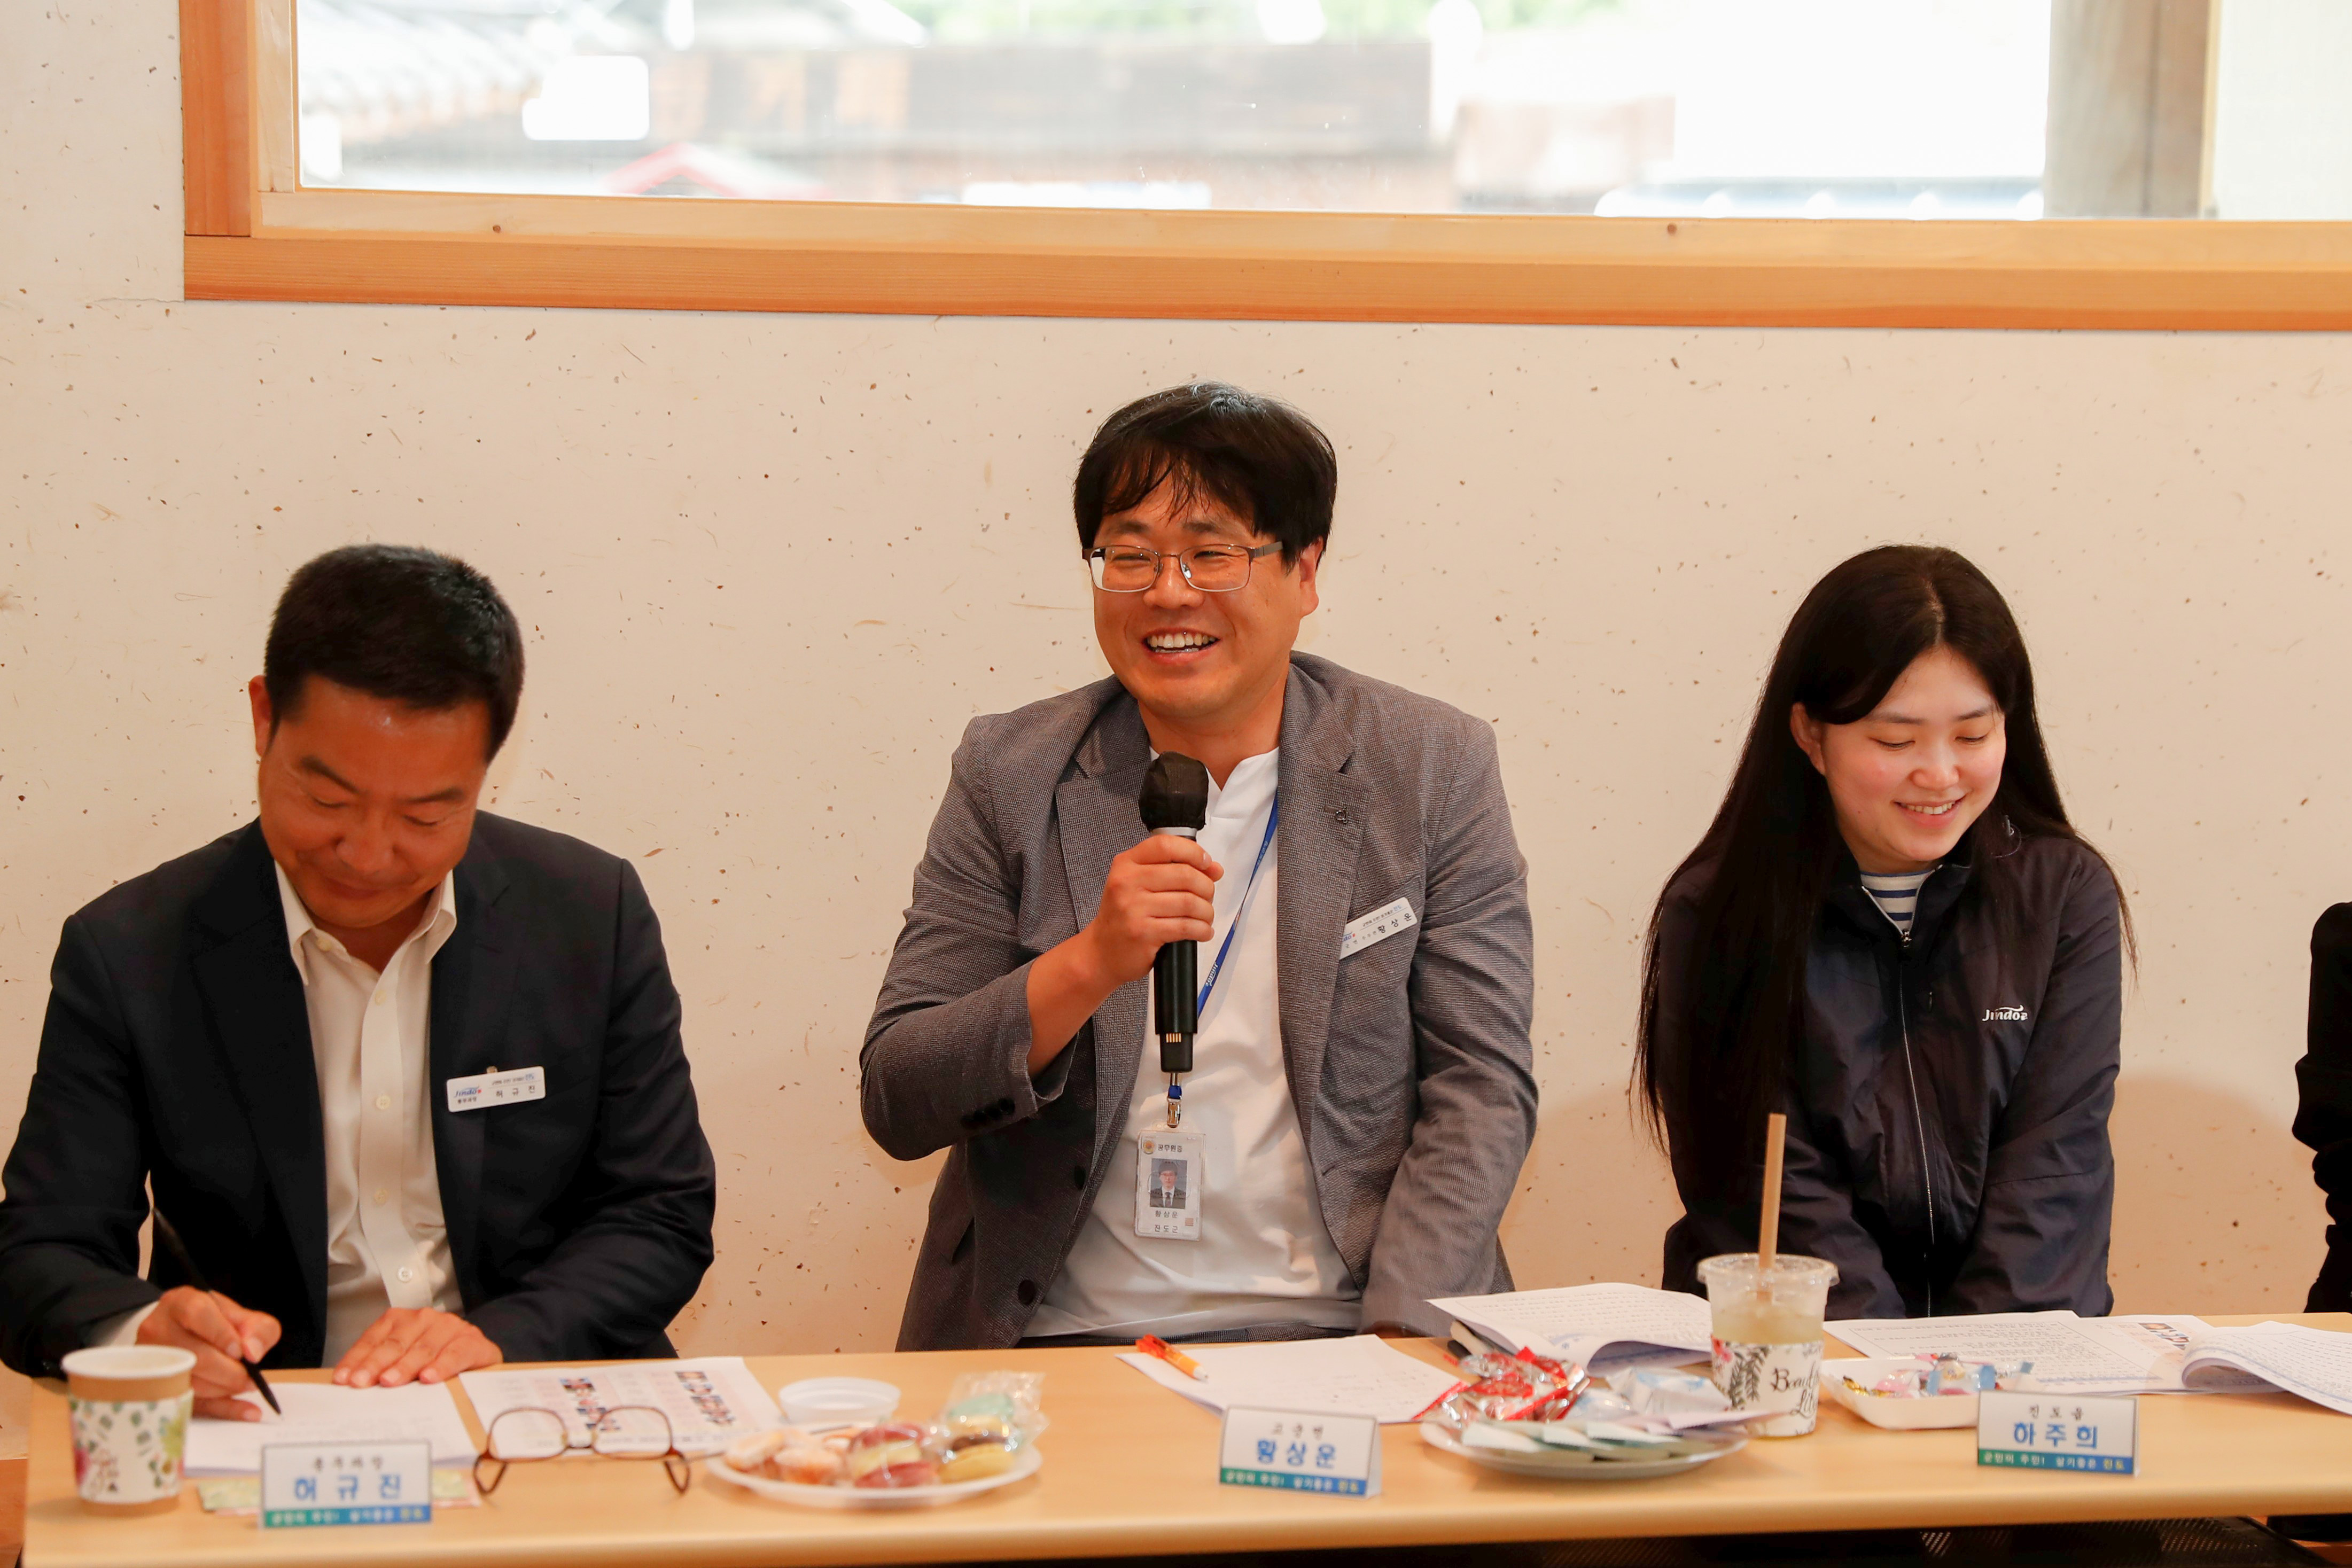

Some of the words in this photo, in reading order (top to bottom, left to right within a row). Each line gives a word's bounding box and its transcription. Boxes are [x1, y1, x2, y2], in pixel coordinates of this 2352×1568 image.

[1377, 913, 1412, 933] 황상운
[1157, 1144, 1183, 1153] 공무원증
[1154, 1224, 1178, 1234] 진도군
[2013, 1422, 2098, 1449] 하주희
[295, 1474, 400, 1501] 허규진
